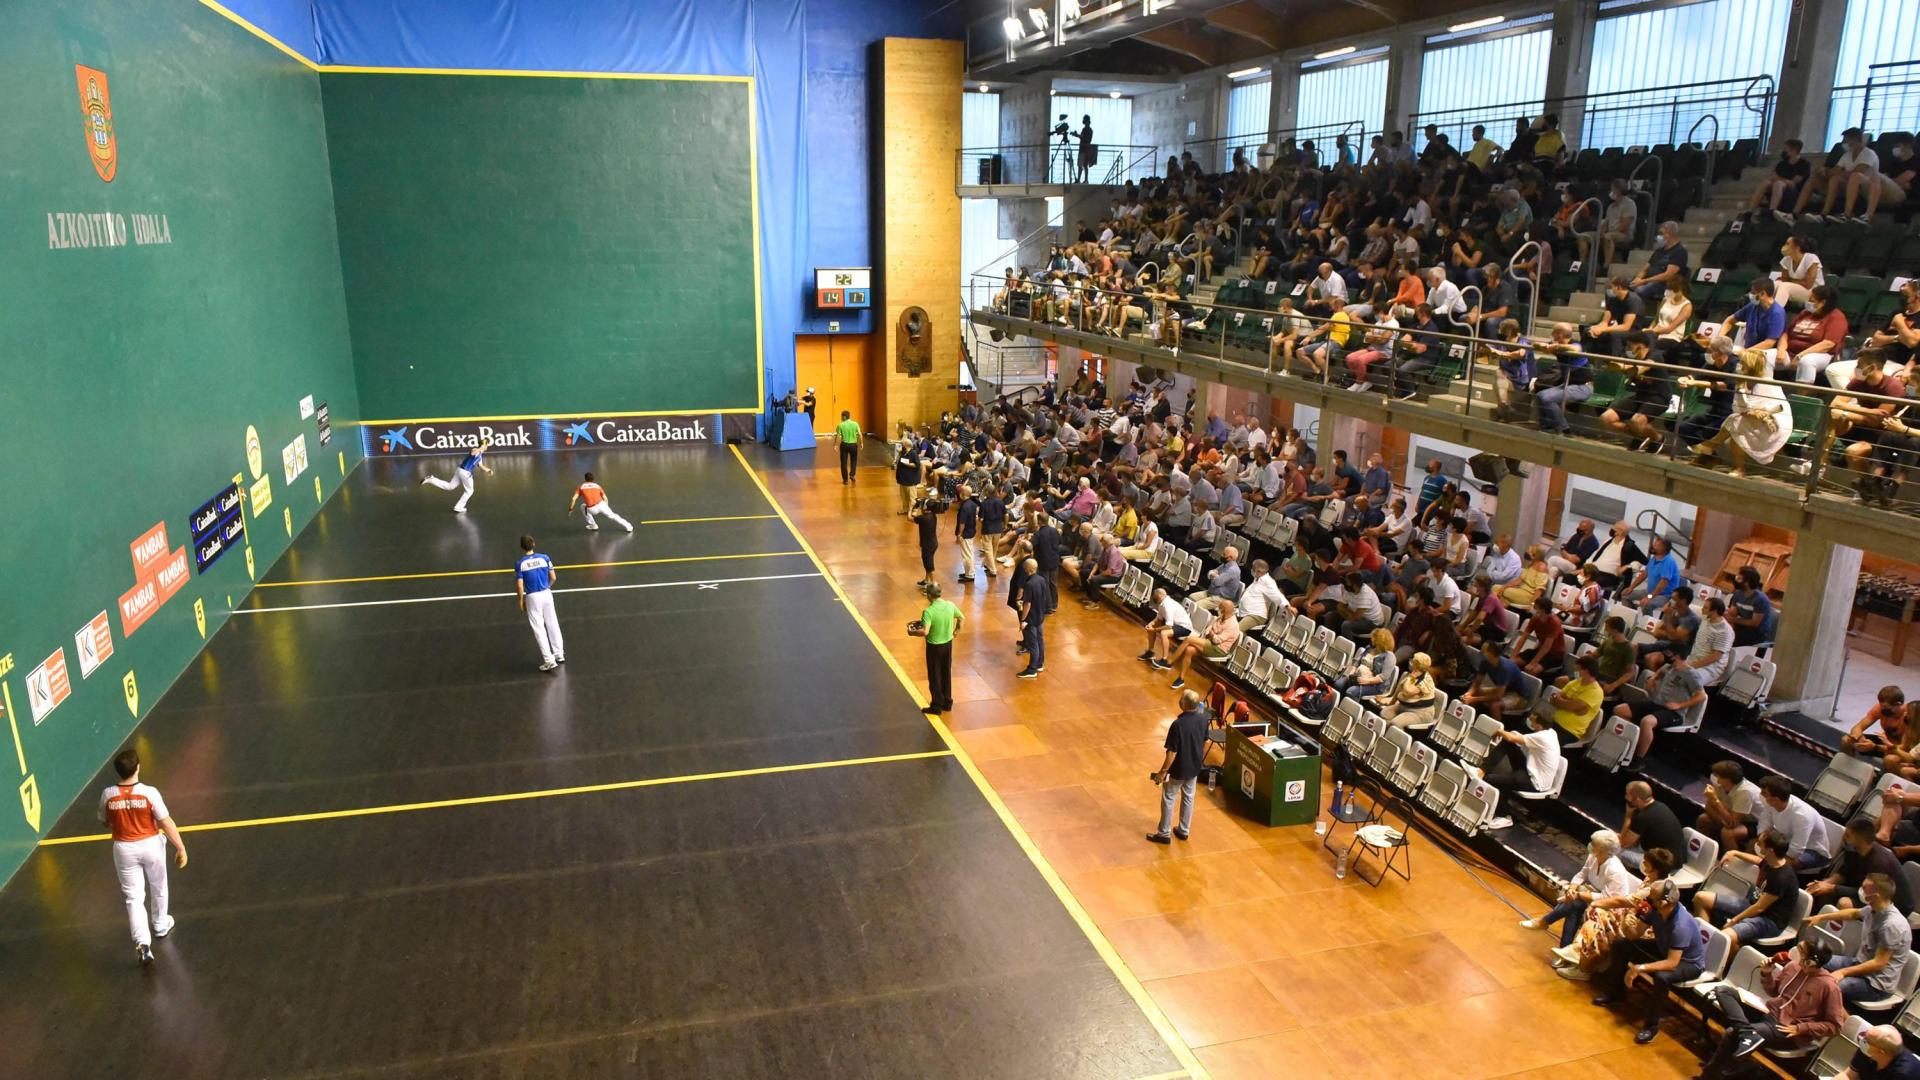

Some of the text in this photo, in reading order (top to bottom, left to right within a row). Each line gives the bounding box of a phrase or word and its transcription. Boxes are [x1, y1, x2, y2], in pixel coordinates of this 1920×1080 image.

[47, 212, 172, 249] AZKOITIKO UDALA
[835, 274, 852, 286] 22
[827, 292, 839, 303] 14
[852, 292, 865, 303] 17
[415, 424, 533, 449] CaixaBank
[596, 419, 707, 443] CaixaBank
[141, 530, 166, 565] AMBAR
[164, 554, 187, 588] AMBAR
[129, 582, 156, 617] AMBAR
[196, 604, 203, 621] 5
[0, 652, 15, 678] ZE
[126, 678, 135, 698] 6
[24, 783, 33, 810] 7
